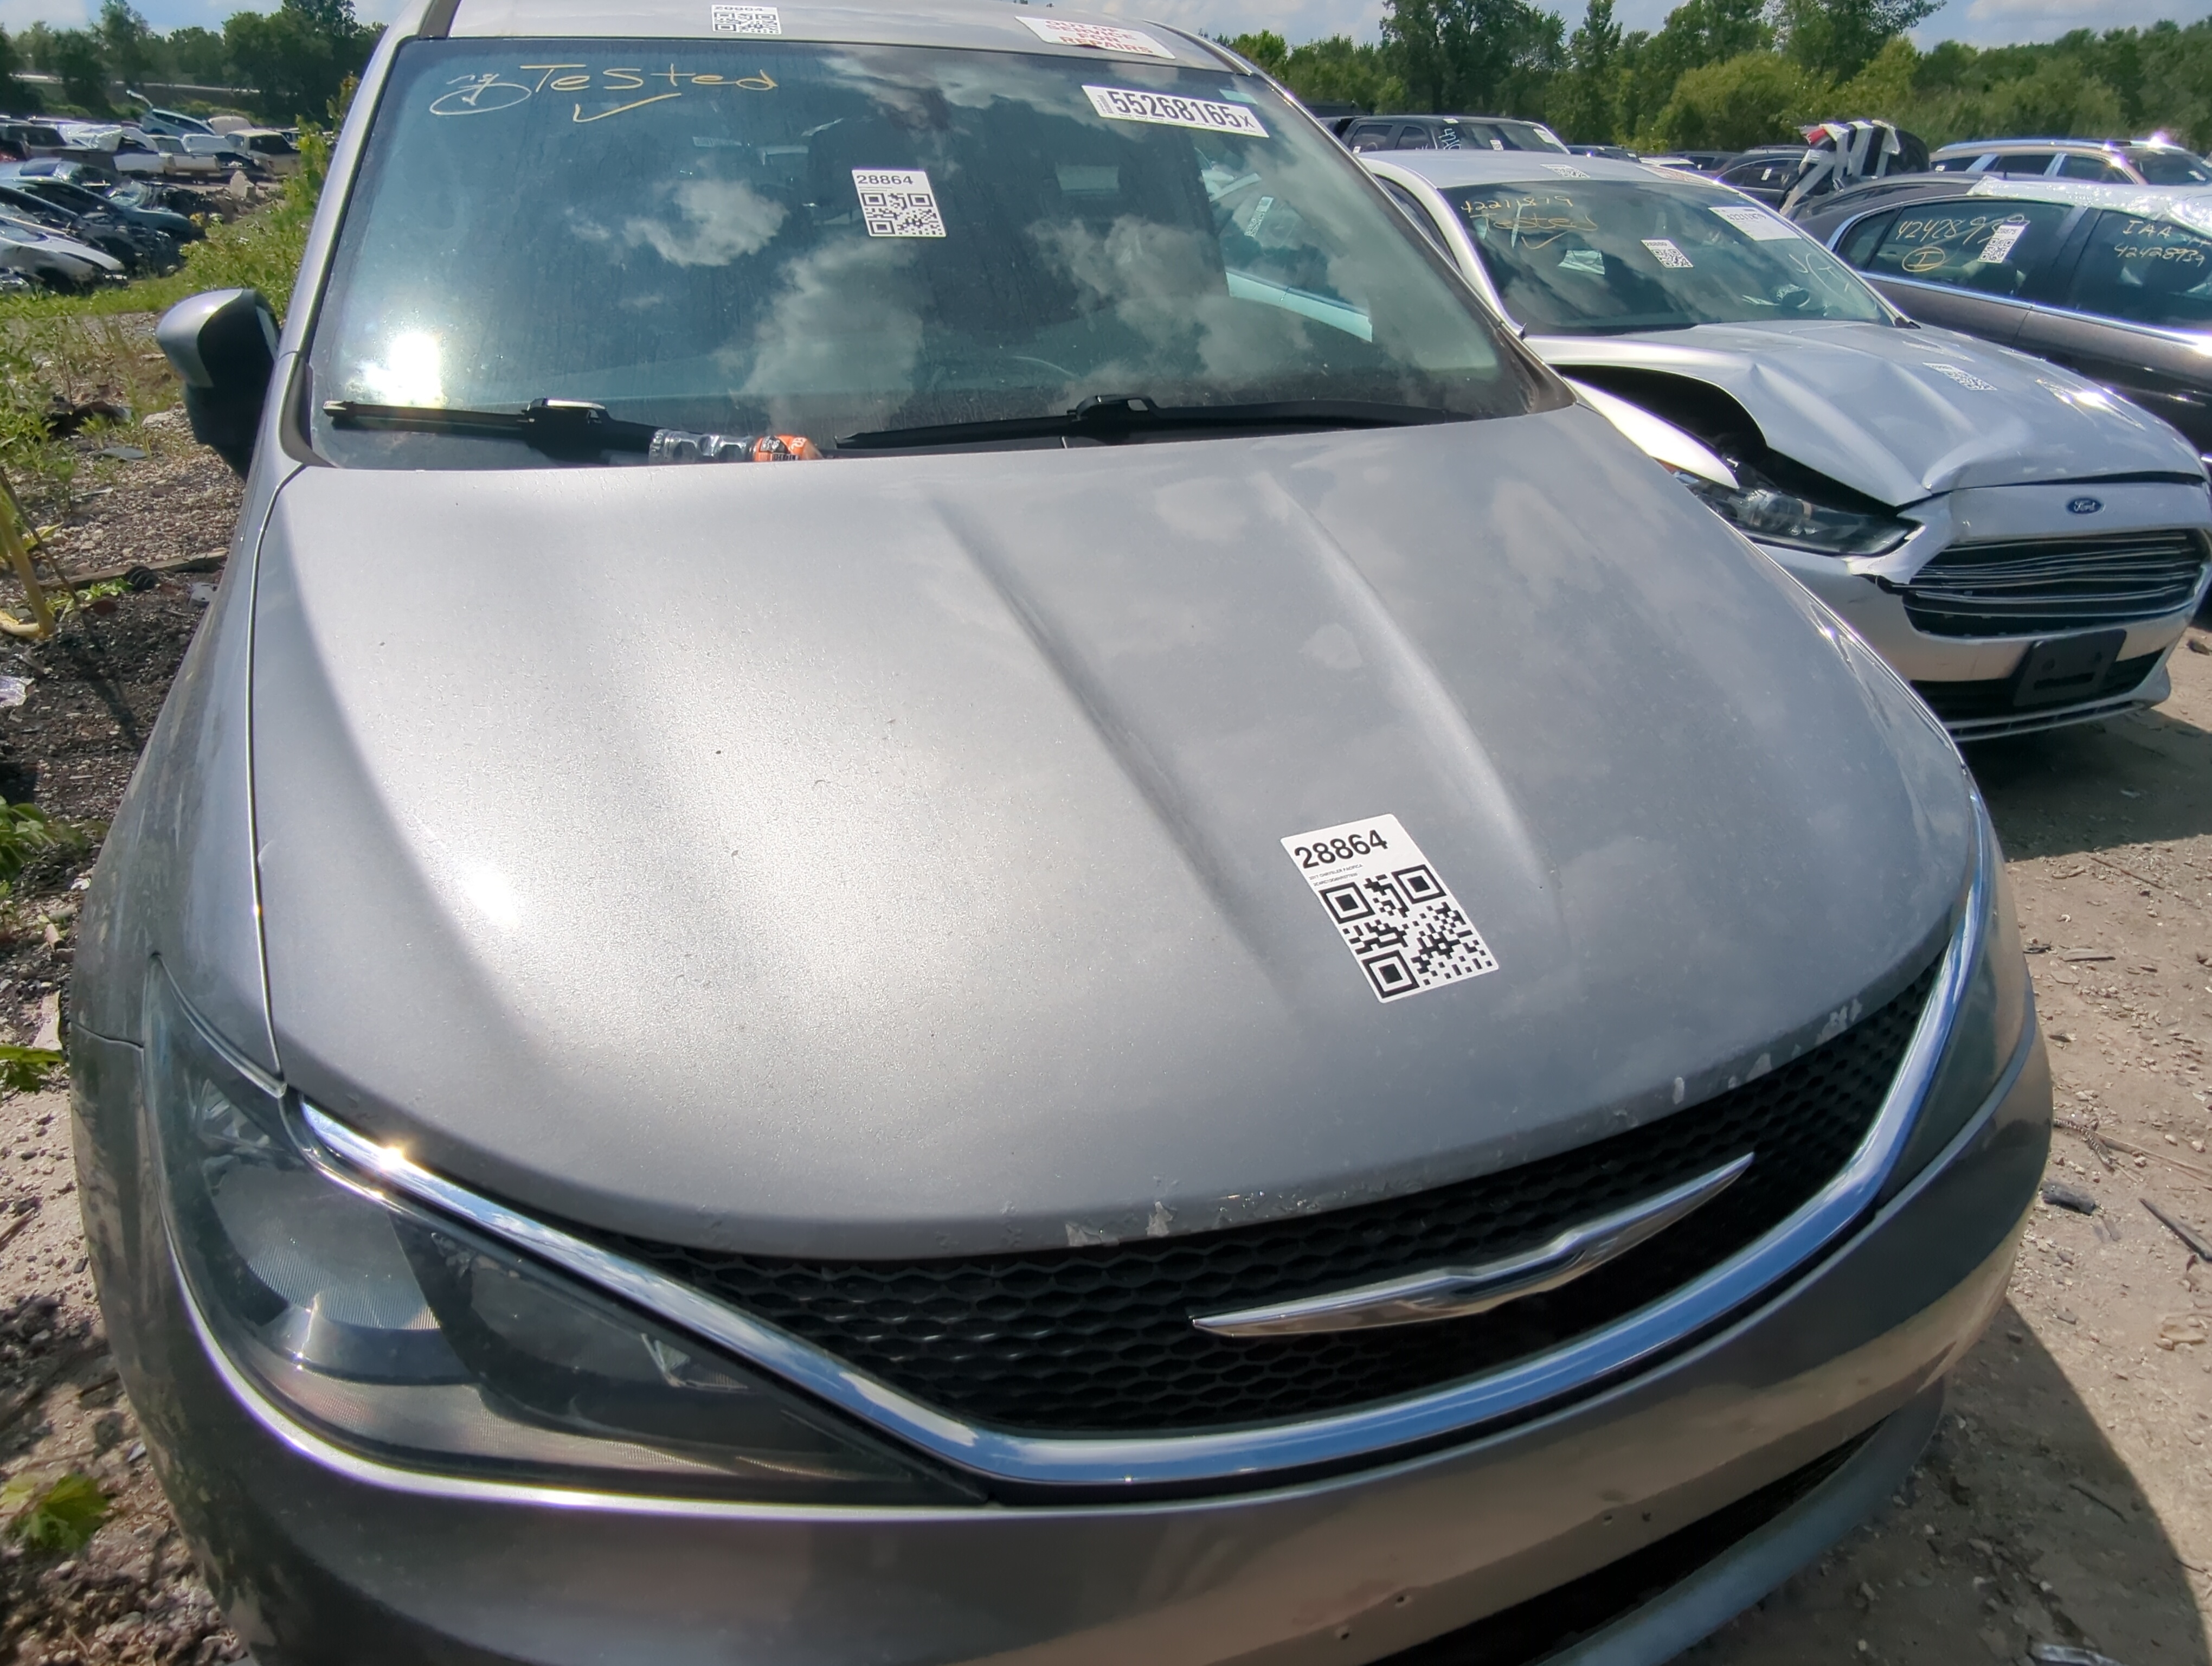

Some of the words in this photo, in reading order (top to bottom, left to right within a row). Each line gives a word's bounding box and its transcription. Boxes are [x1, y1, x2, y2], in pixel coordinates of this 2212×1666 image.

[1045, 24, 1137, 40] SERVICE
[1076, 33, 1121, 43] FOR
[1058, 36, 1154, 53] REPAIRS
[856, 175, 914, 185] 28864
[2074, 501, 2096, 511] Ford
[1294, 830, 1388, 869] 28864
